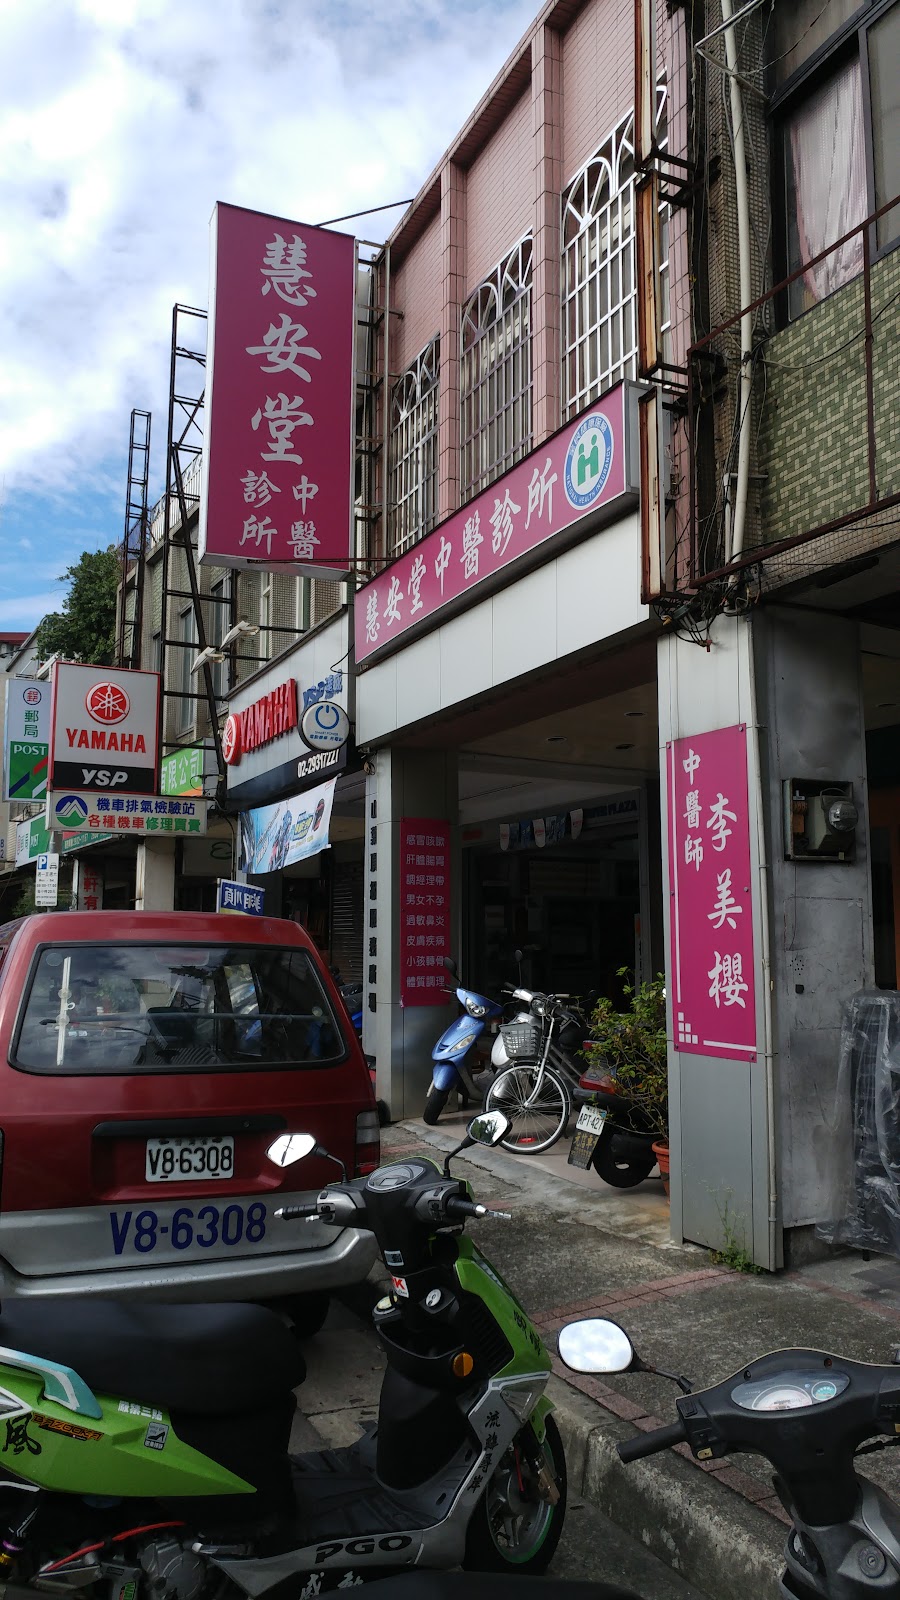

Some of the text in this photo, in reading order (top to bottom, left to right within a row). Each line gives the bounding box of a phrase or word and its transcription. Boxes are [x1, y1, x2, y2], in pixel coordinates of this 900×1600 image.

[246, 233, 322, 465] 慧安堂
[239, 470, 282, 555] 診所
[286, 475, 321, 560] 中醫
[366, 457, 558, 643] 慧安堂中醫診所
[23, 709, 39, 738] 郵局
[240, 677, 298, 754] YAMAHA
[13, 744, 47, 756] POST
[65, 728, 147, 753] YAMAHA
[81, 768, 129, 787] YSP
[96, 797, 196, 816] 機車排氣檢驗站
[683, 748, 704, 873] 中醫師
[88, 814, 201, 833] 各種機車修理買賣
[406, 834, 445, 847] 感冒咳嗽
[39, 856, 46, 869] P
[406, 854, 445, 867] 肝膽腸胃
[406, 894, 445, 906] 男女不孕
[706, 792, 749, 1009] 李美櫻
[406, 914, 445, 927] 過敏鼻炎
[406, 935, 445, 947] 皮膚疾病
[406, 976, 445, 987] 體質調理
[148, 1146, 232, 1176] V8-6308
[110, 1202, 267, 1255] V8-6308
[314, 1535, 413, 1564] PGO
